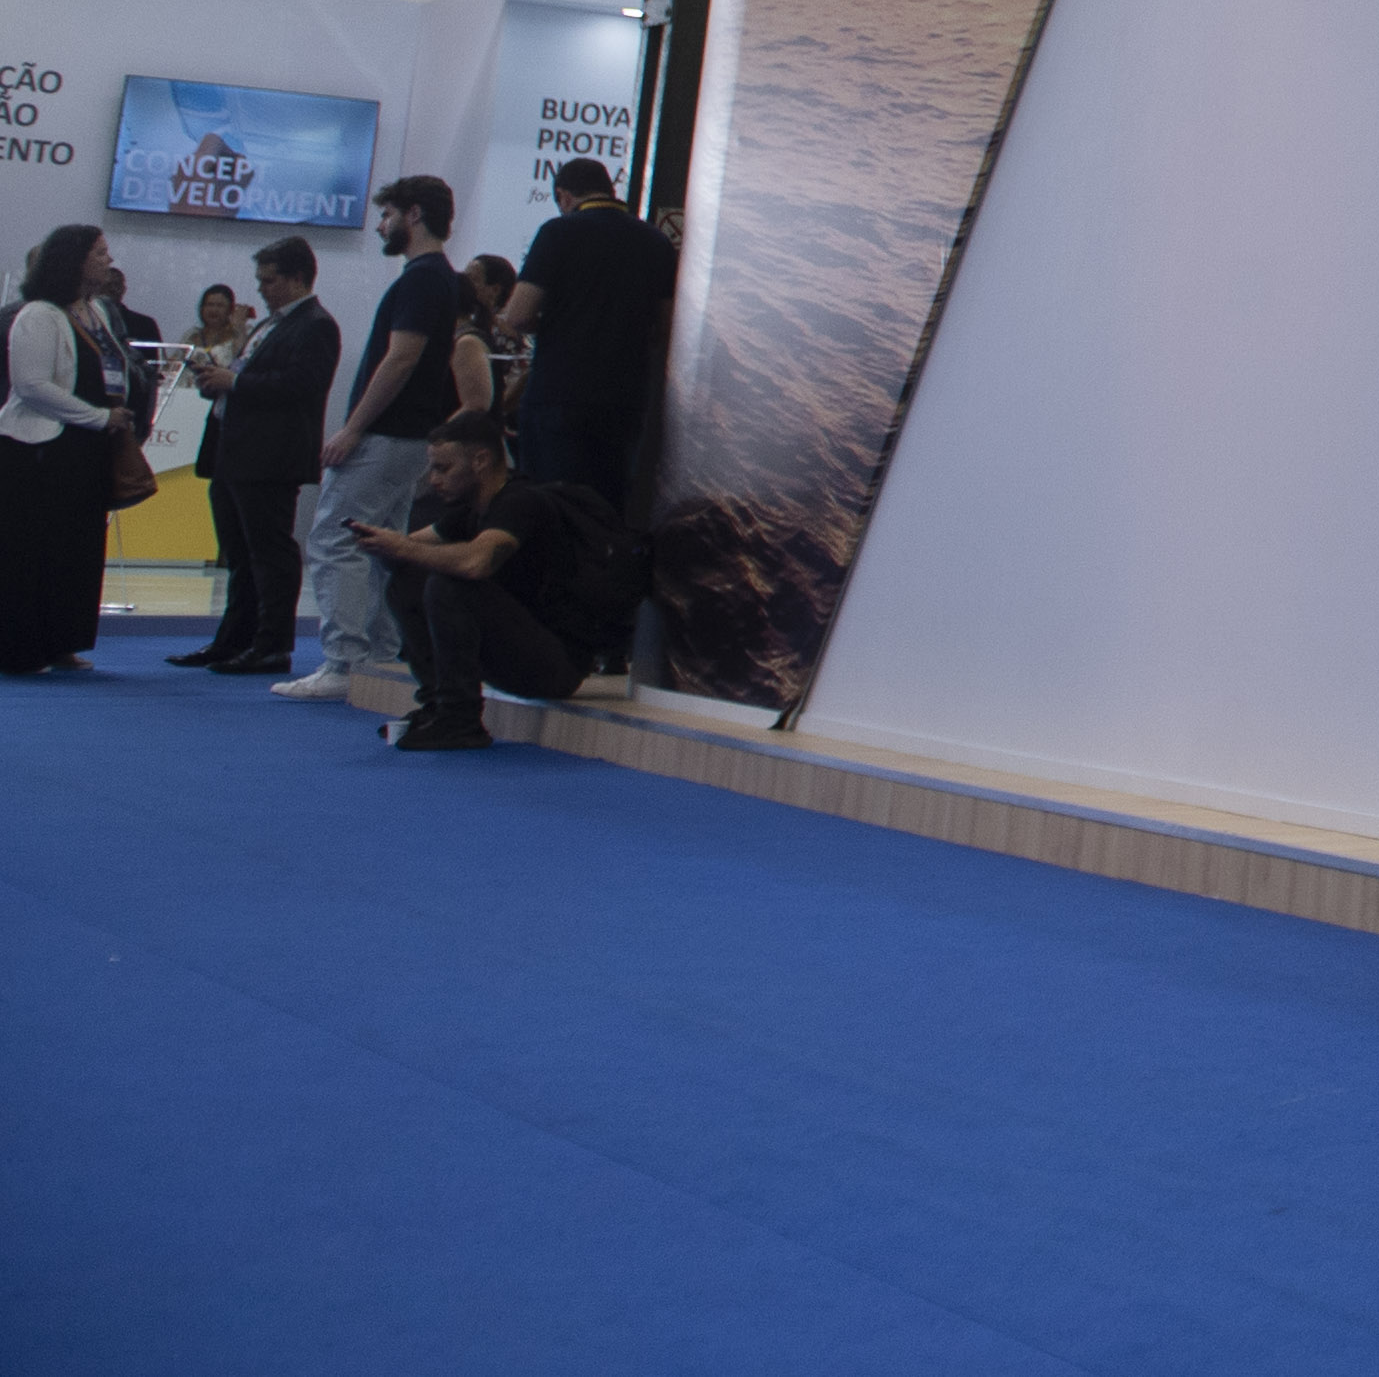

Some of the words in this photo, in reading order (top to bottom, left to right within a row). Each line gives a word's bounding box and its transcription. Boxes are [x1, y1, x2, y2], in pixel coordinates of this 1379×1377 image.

[541, 97, 632, 128] BUOYA
[537, 128, 628, 158] PROTE
[125, 149, 269, 185] CONCEPT
[121, 176, 358, 218] DEVELOPMENT
